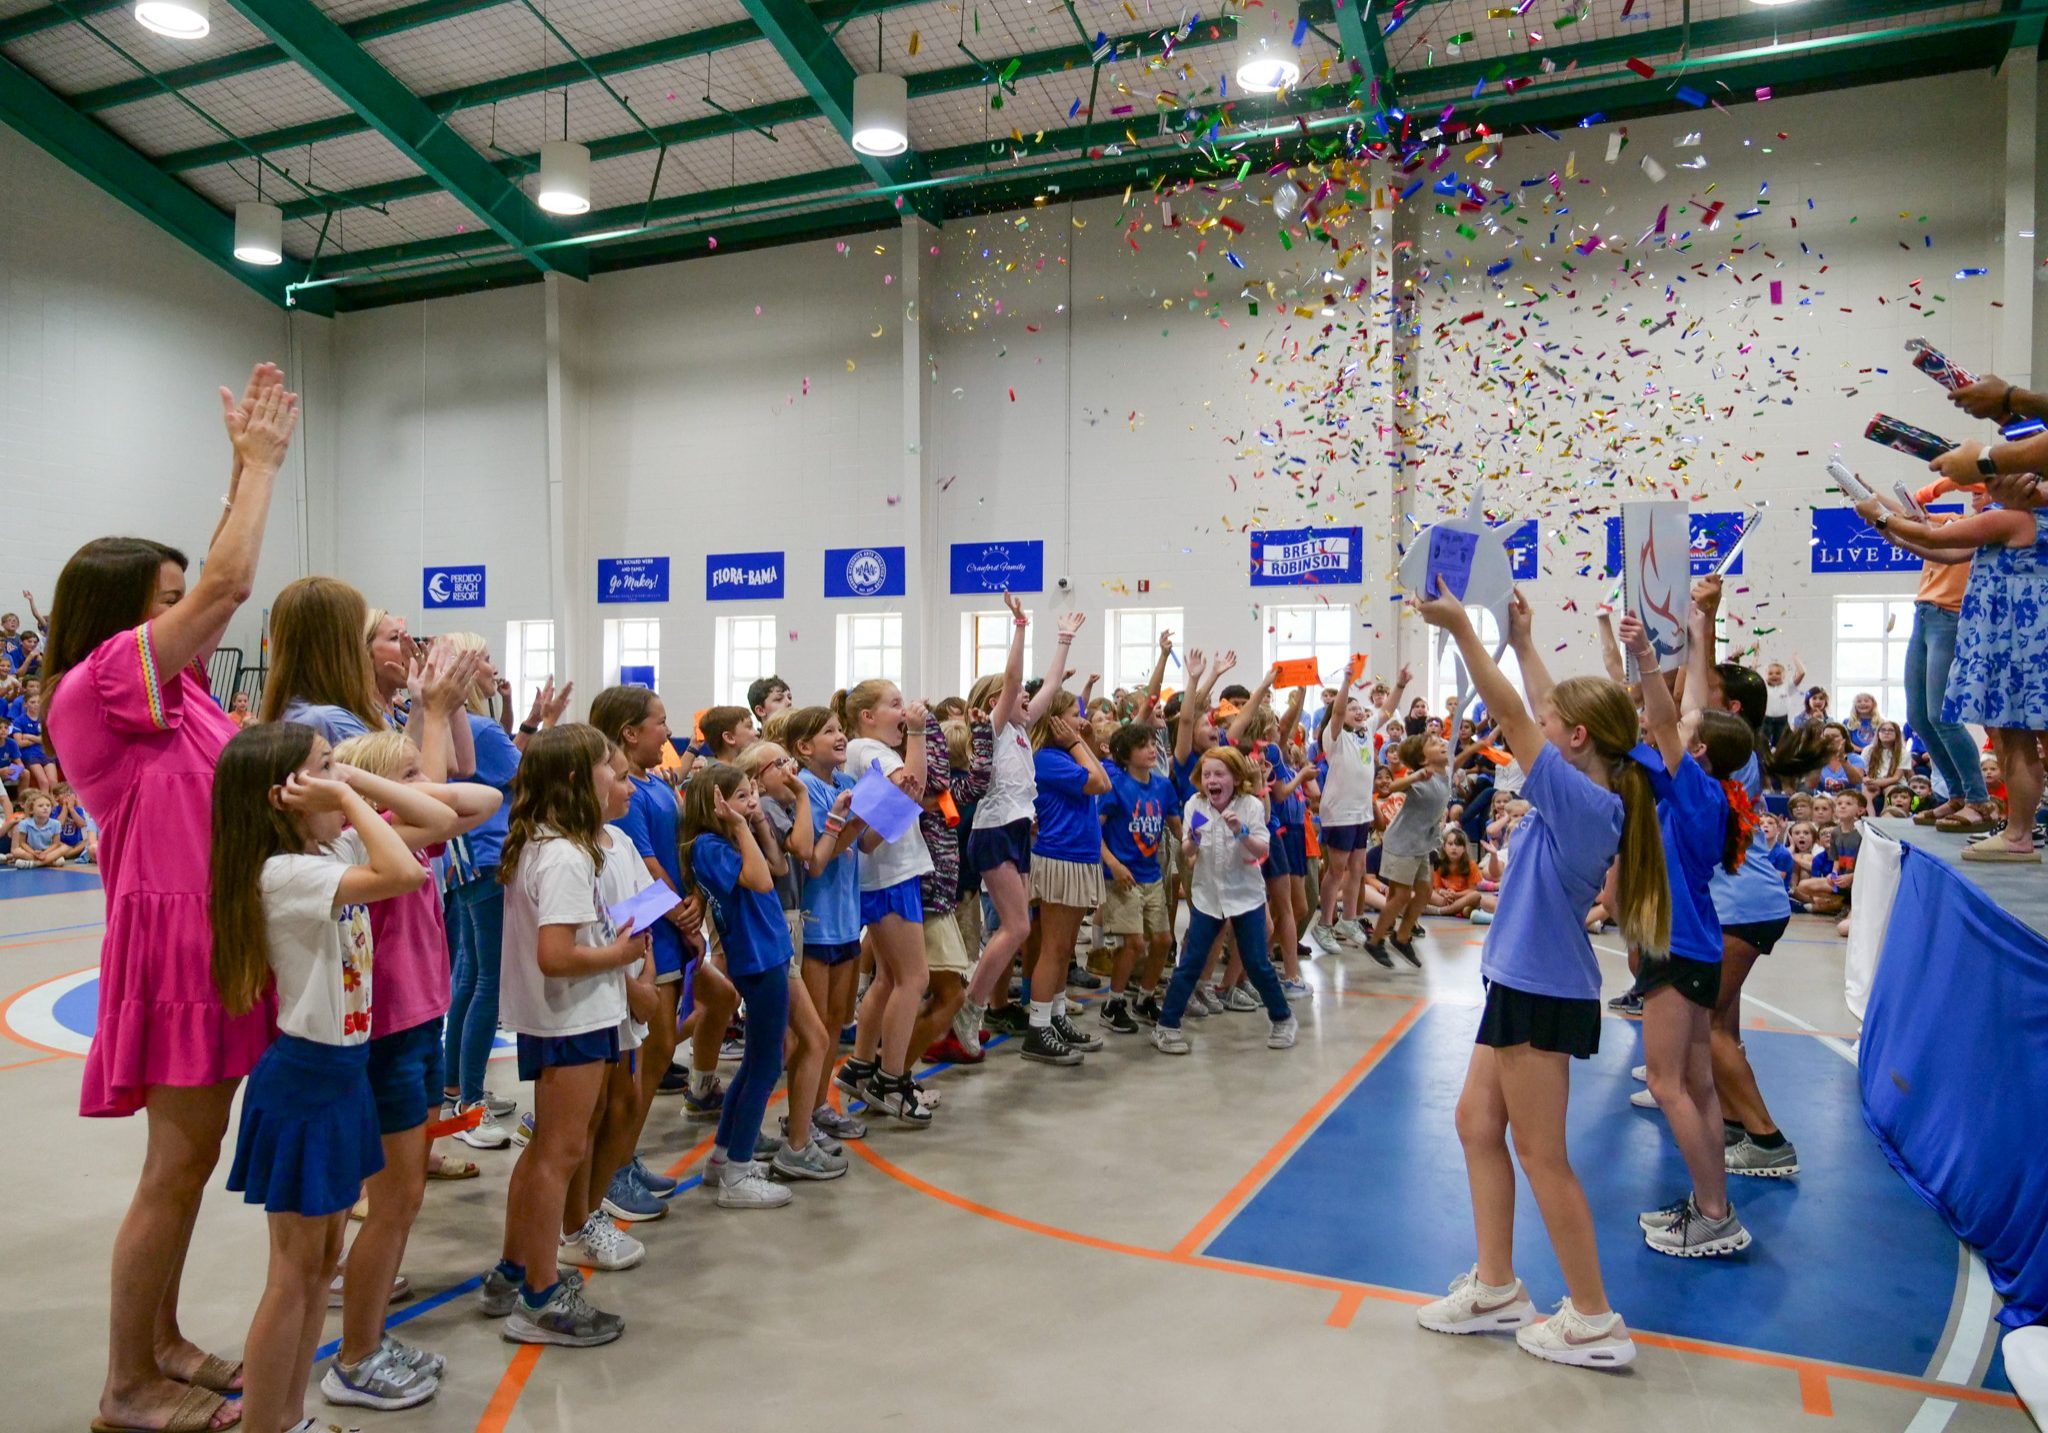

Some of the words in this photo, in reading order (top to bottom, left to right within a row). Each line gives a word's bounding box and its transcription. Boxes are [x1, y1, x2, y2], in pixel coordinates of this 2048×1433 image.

[1283, 540, 1327, 558] BRETT
[1820, 547, 1880, 563] LIVE
[1890, 547, 1921, 561] BA
[1000, 561, 1026, 573] Family
[1272, 554, 1341, 575] ROBINSON
[450, 573, 482, 583] PERDIDO
[609, 575, 622, 594] Go
[624, 573, 659, 591] Makos!
[712, 565, 778, 588] FLORA-BAMA
[454, 582, 478, 592] BEACH
[452, 591, 480, 601] RESORT
